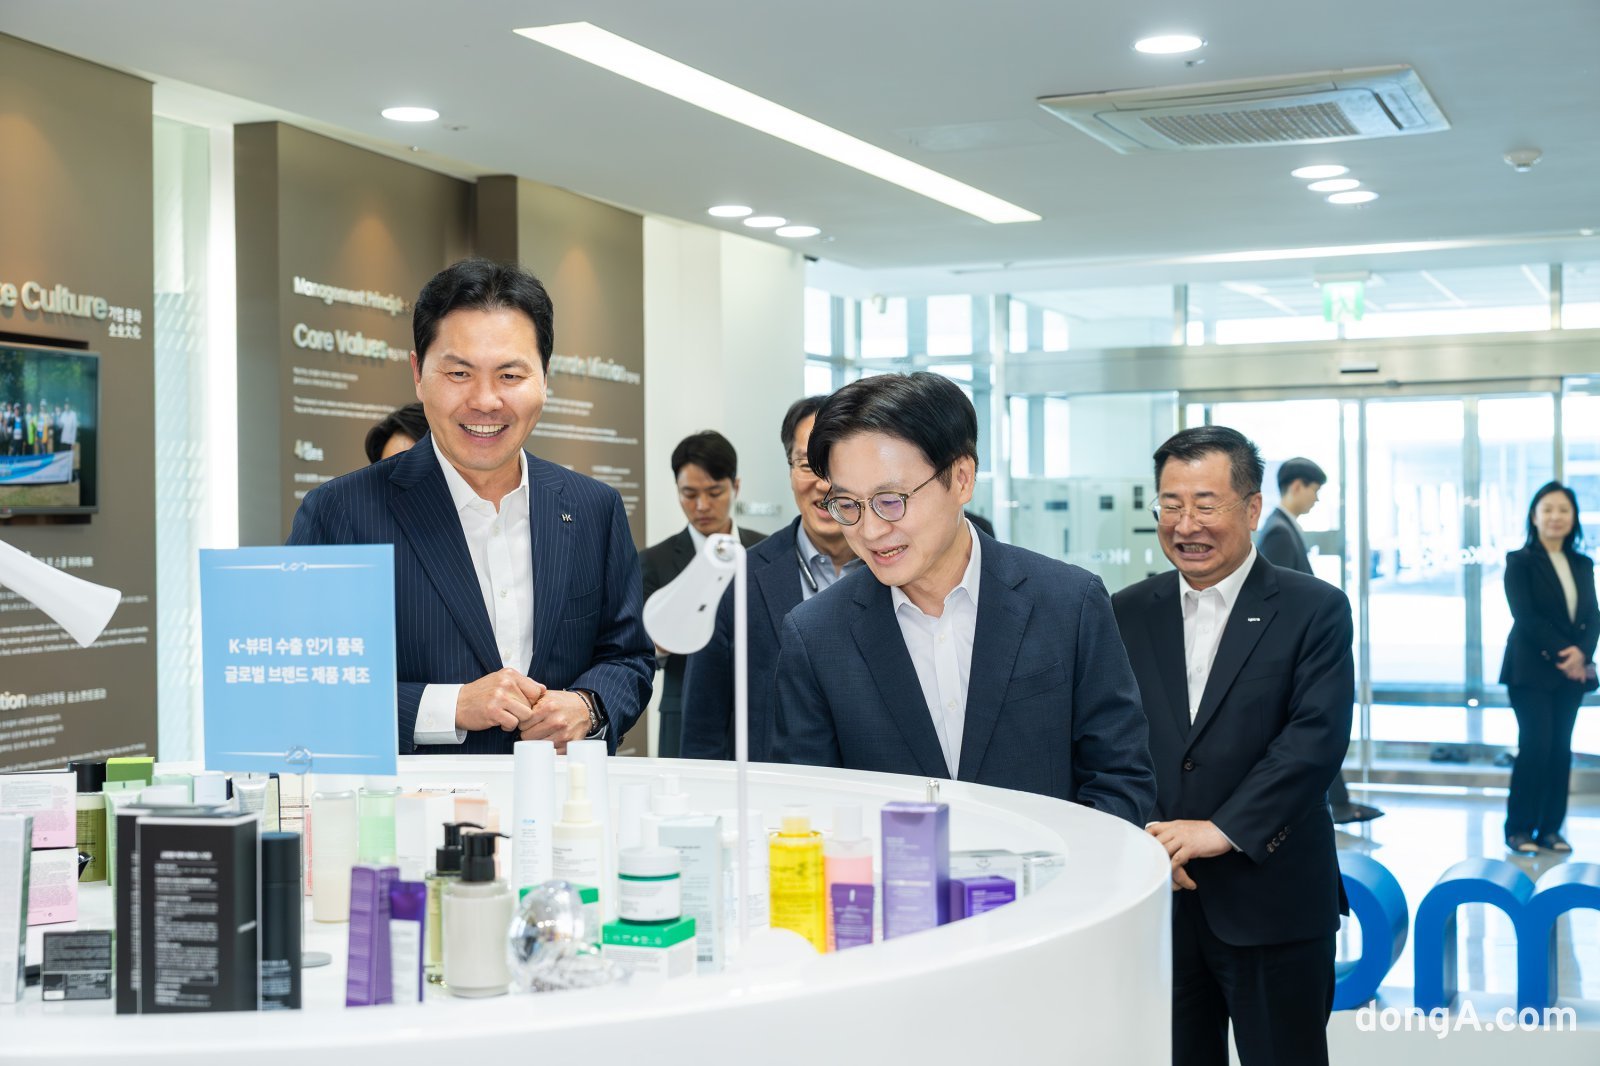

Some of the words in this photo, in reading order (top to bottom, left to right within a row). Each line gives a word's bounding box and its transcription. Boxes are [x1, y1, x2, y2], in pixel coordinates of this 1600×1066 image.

[21, 281, 108, 320] Culture
[293, 323, 334, 352] Core
[335, 329, 388, 359] Values
[228, 637, 272, 656] K-뷰티
[275, 637, 303, 656] 수출
[305, 637, 333, 656] 인기
[336, 637, 365, 656] 품목
[224, 665, 265, 684] 글로벌
[268, 666, 309, 684] 브랜드
[311, 666, 339, 685] 제품
[342, 666, 371, 684] 제조
